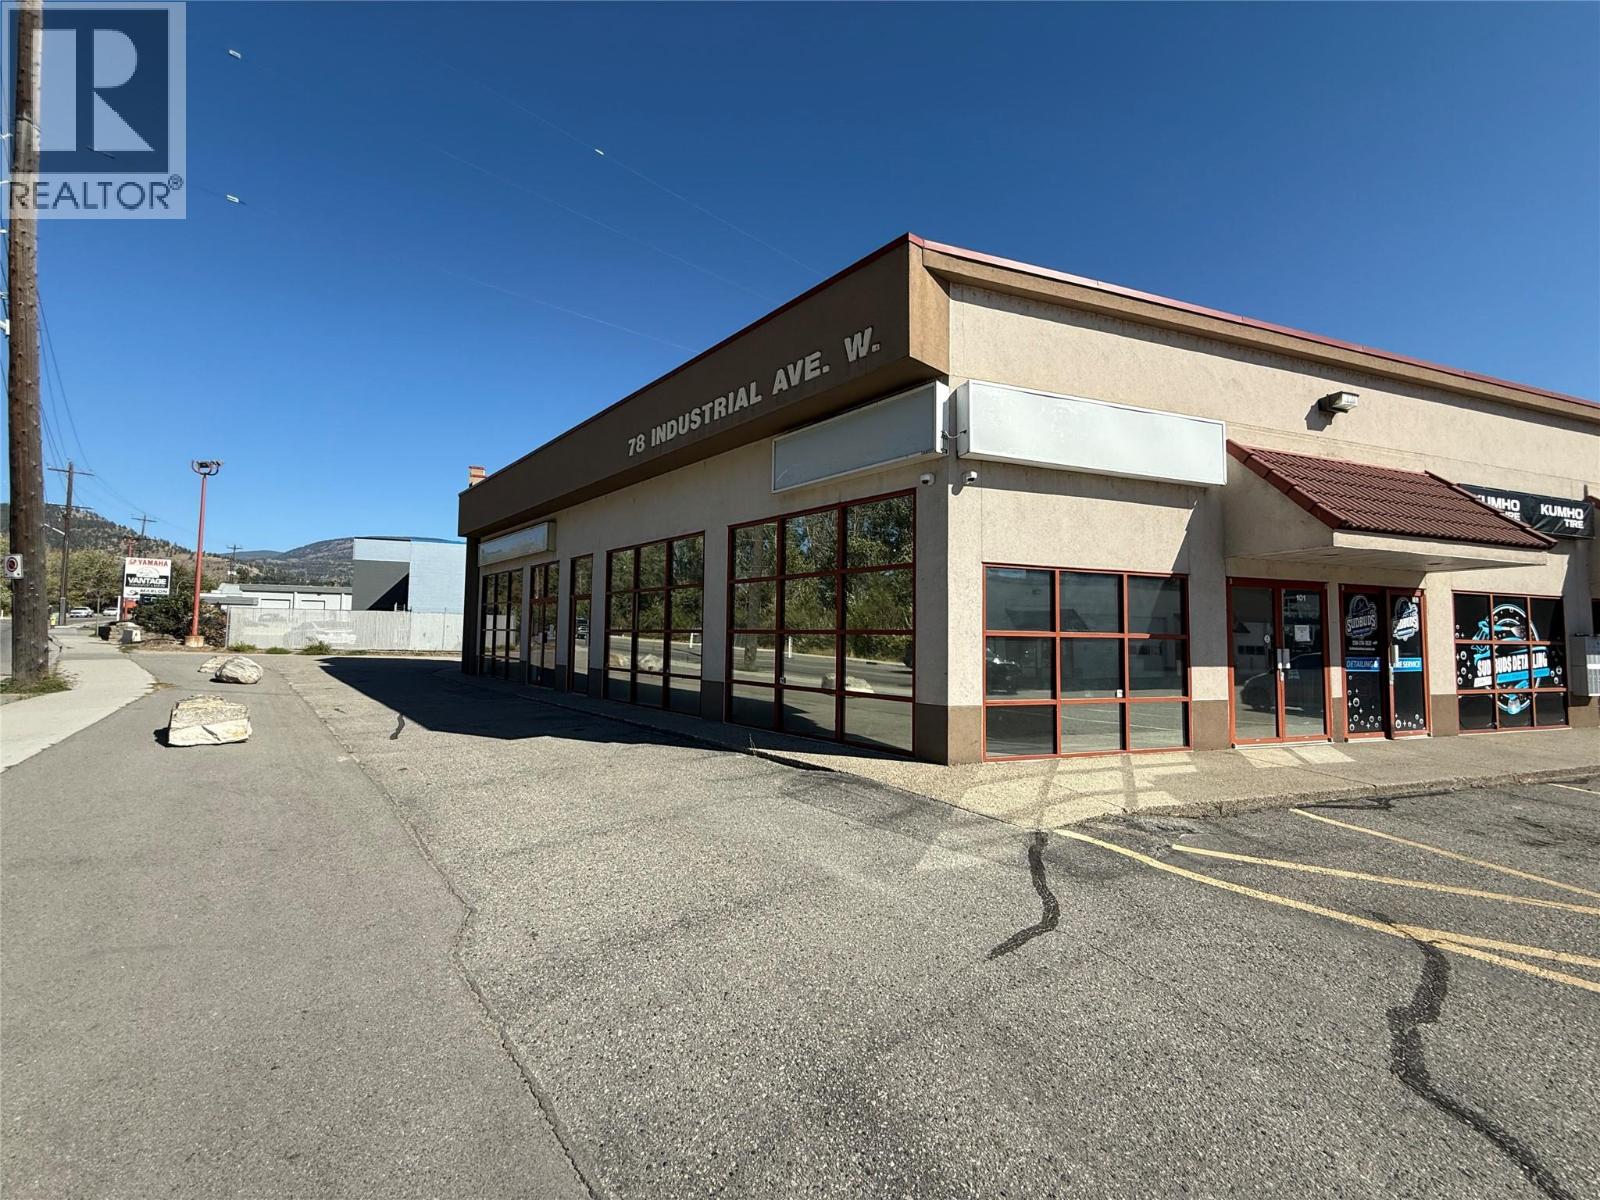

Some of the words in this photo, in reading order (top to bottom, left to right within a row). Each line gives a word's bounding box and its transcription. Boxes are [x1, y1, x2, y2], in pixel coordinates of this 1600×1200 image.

[628, 434, 646, 456] 78
[650, 382, 762, 447] INDUSTRIAL
[772, 351, 830, 395] AVE.
[844, 327, 881, 362] W.
[1540, 503, 1584, 520] KUMHO
[1563, 518, 1584, 529] TIRE
[128, 577, 167, 585] VANTAGE
